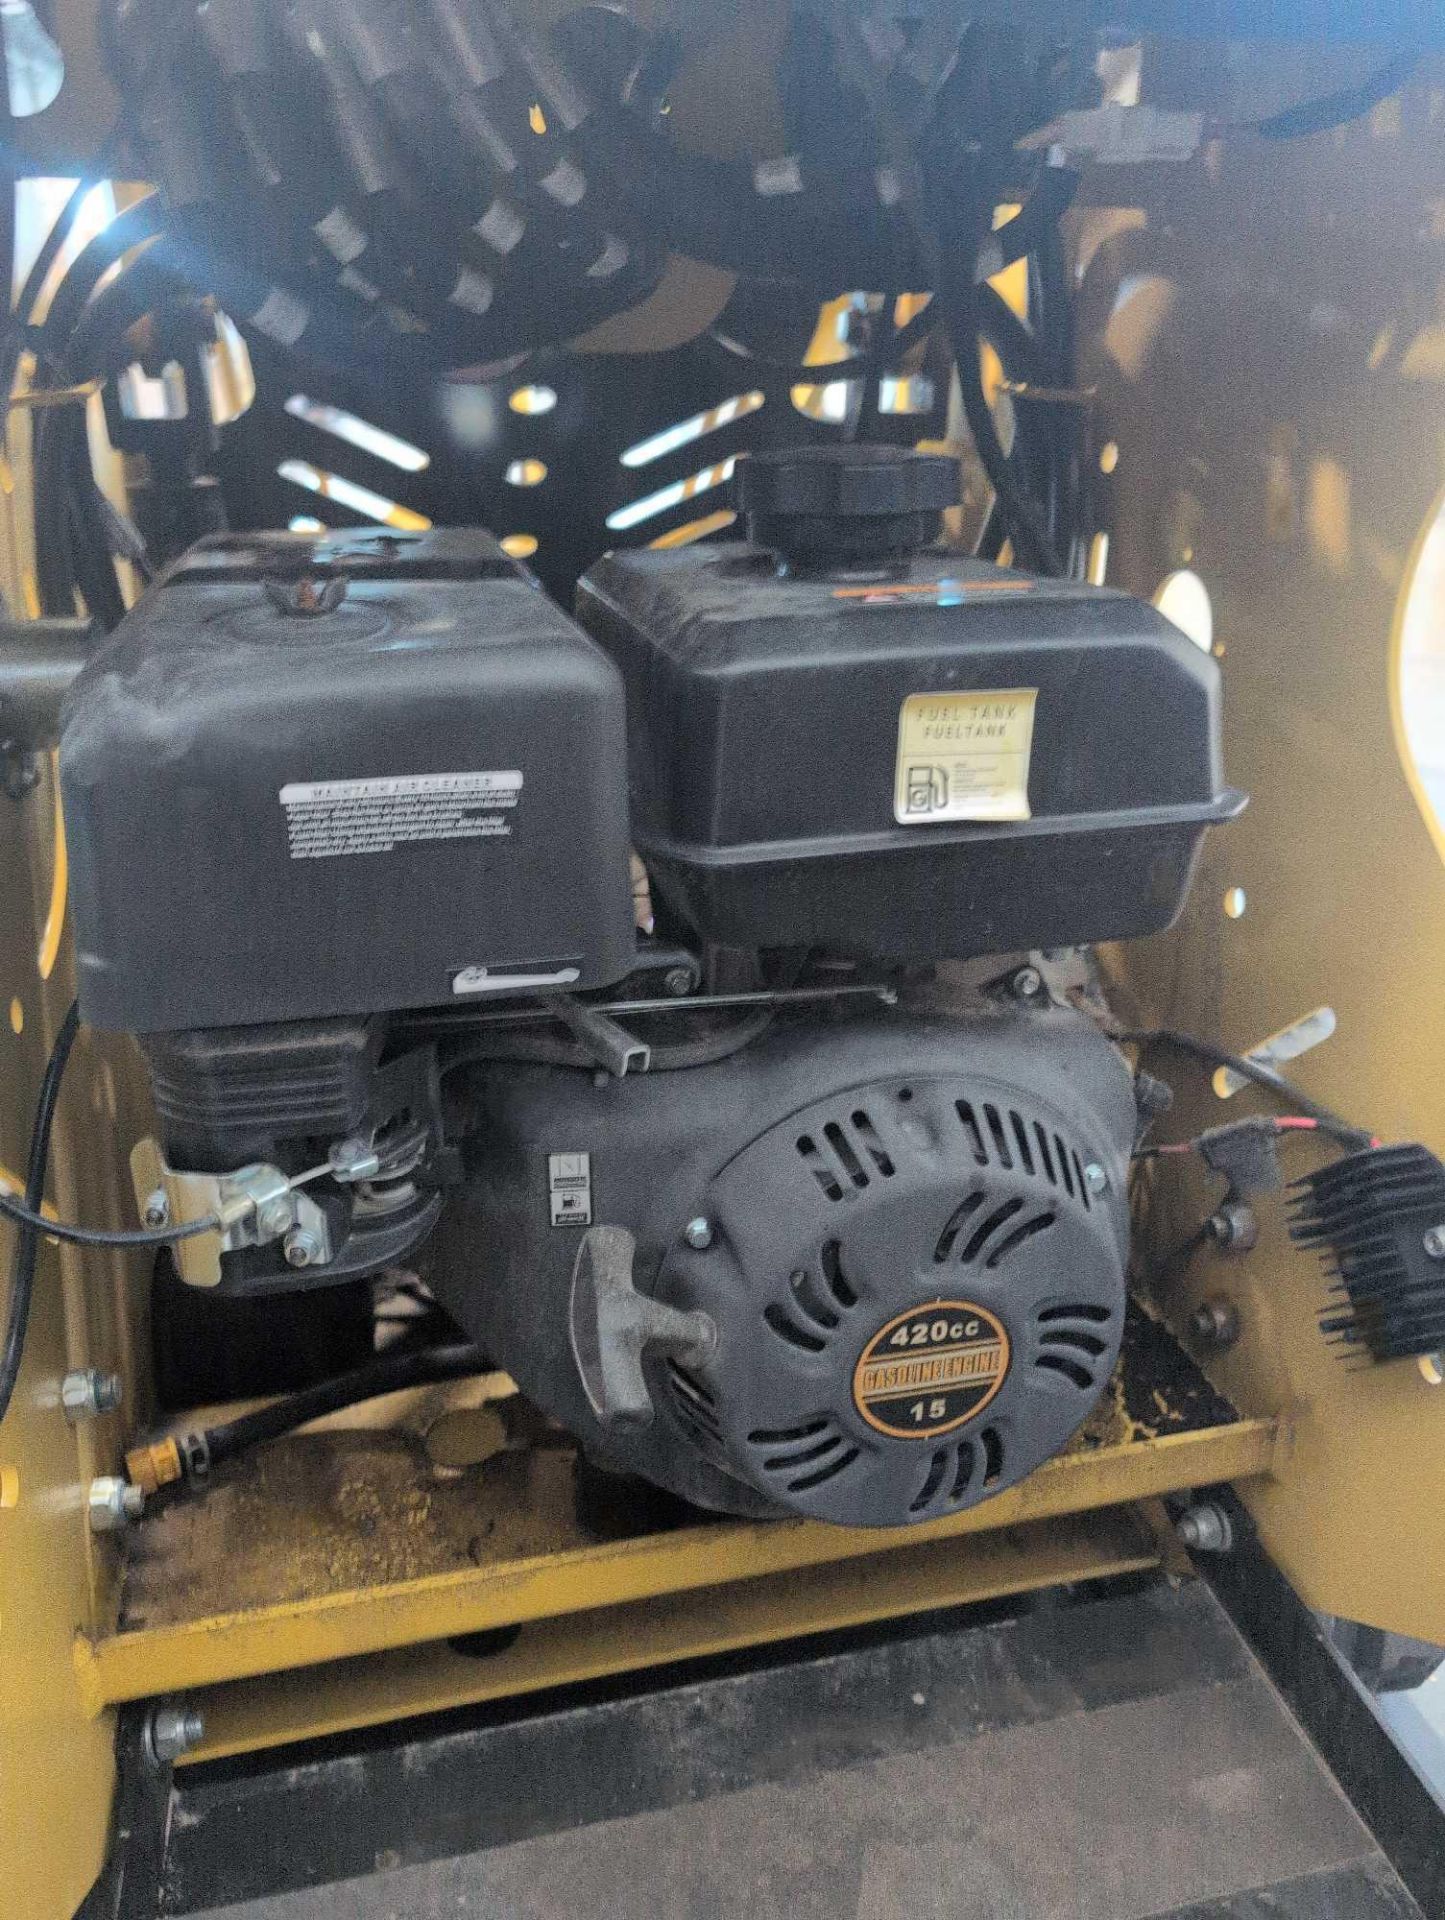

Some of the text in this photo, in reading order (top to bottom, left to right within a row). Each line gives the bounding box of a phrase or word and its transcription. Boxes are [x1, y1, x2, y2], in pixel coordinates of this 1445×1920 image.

[916, 703, 1017, 721] FUEL TANK
[890, 1320, 979, 1345] 420cc
[910, 1399, 946, 1421] 15
